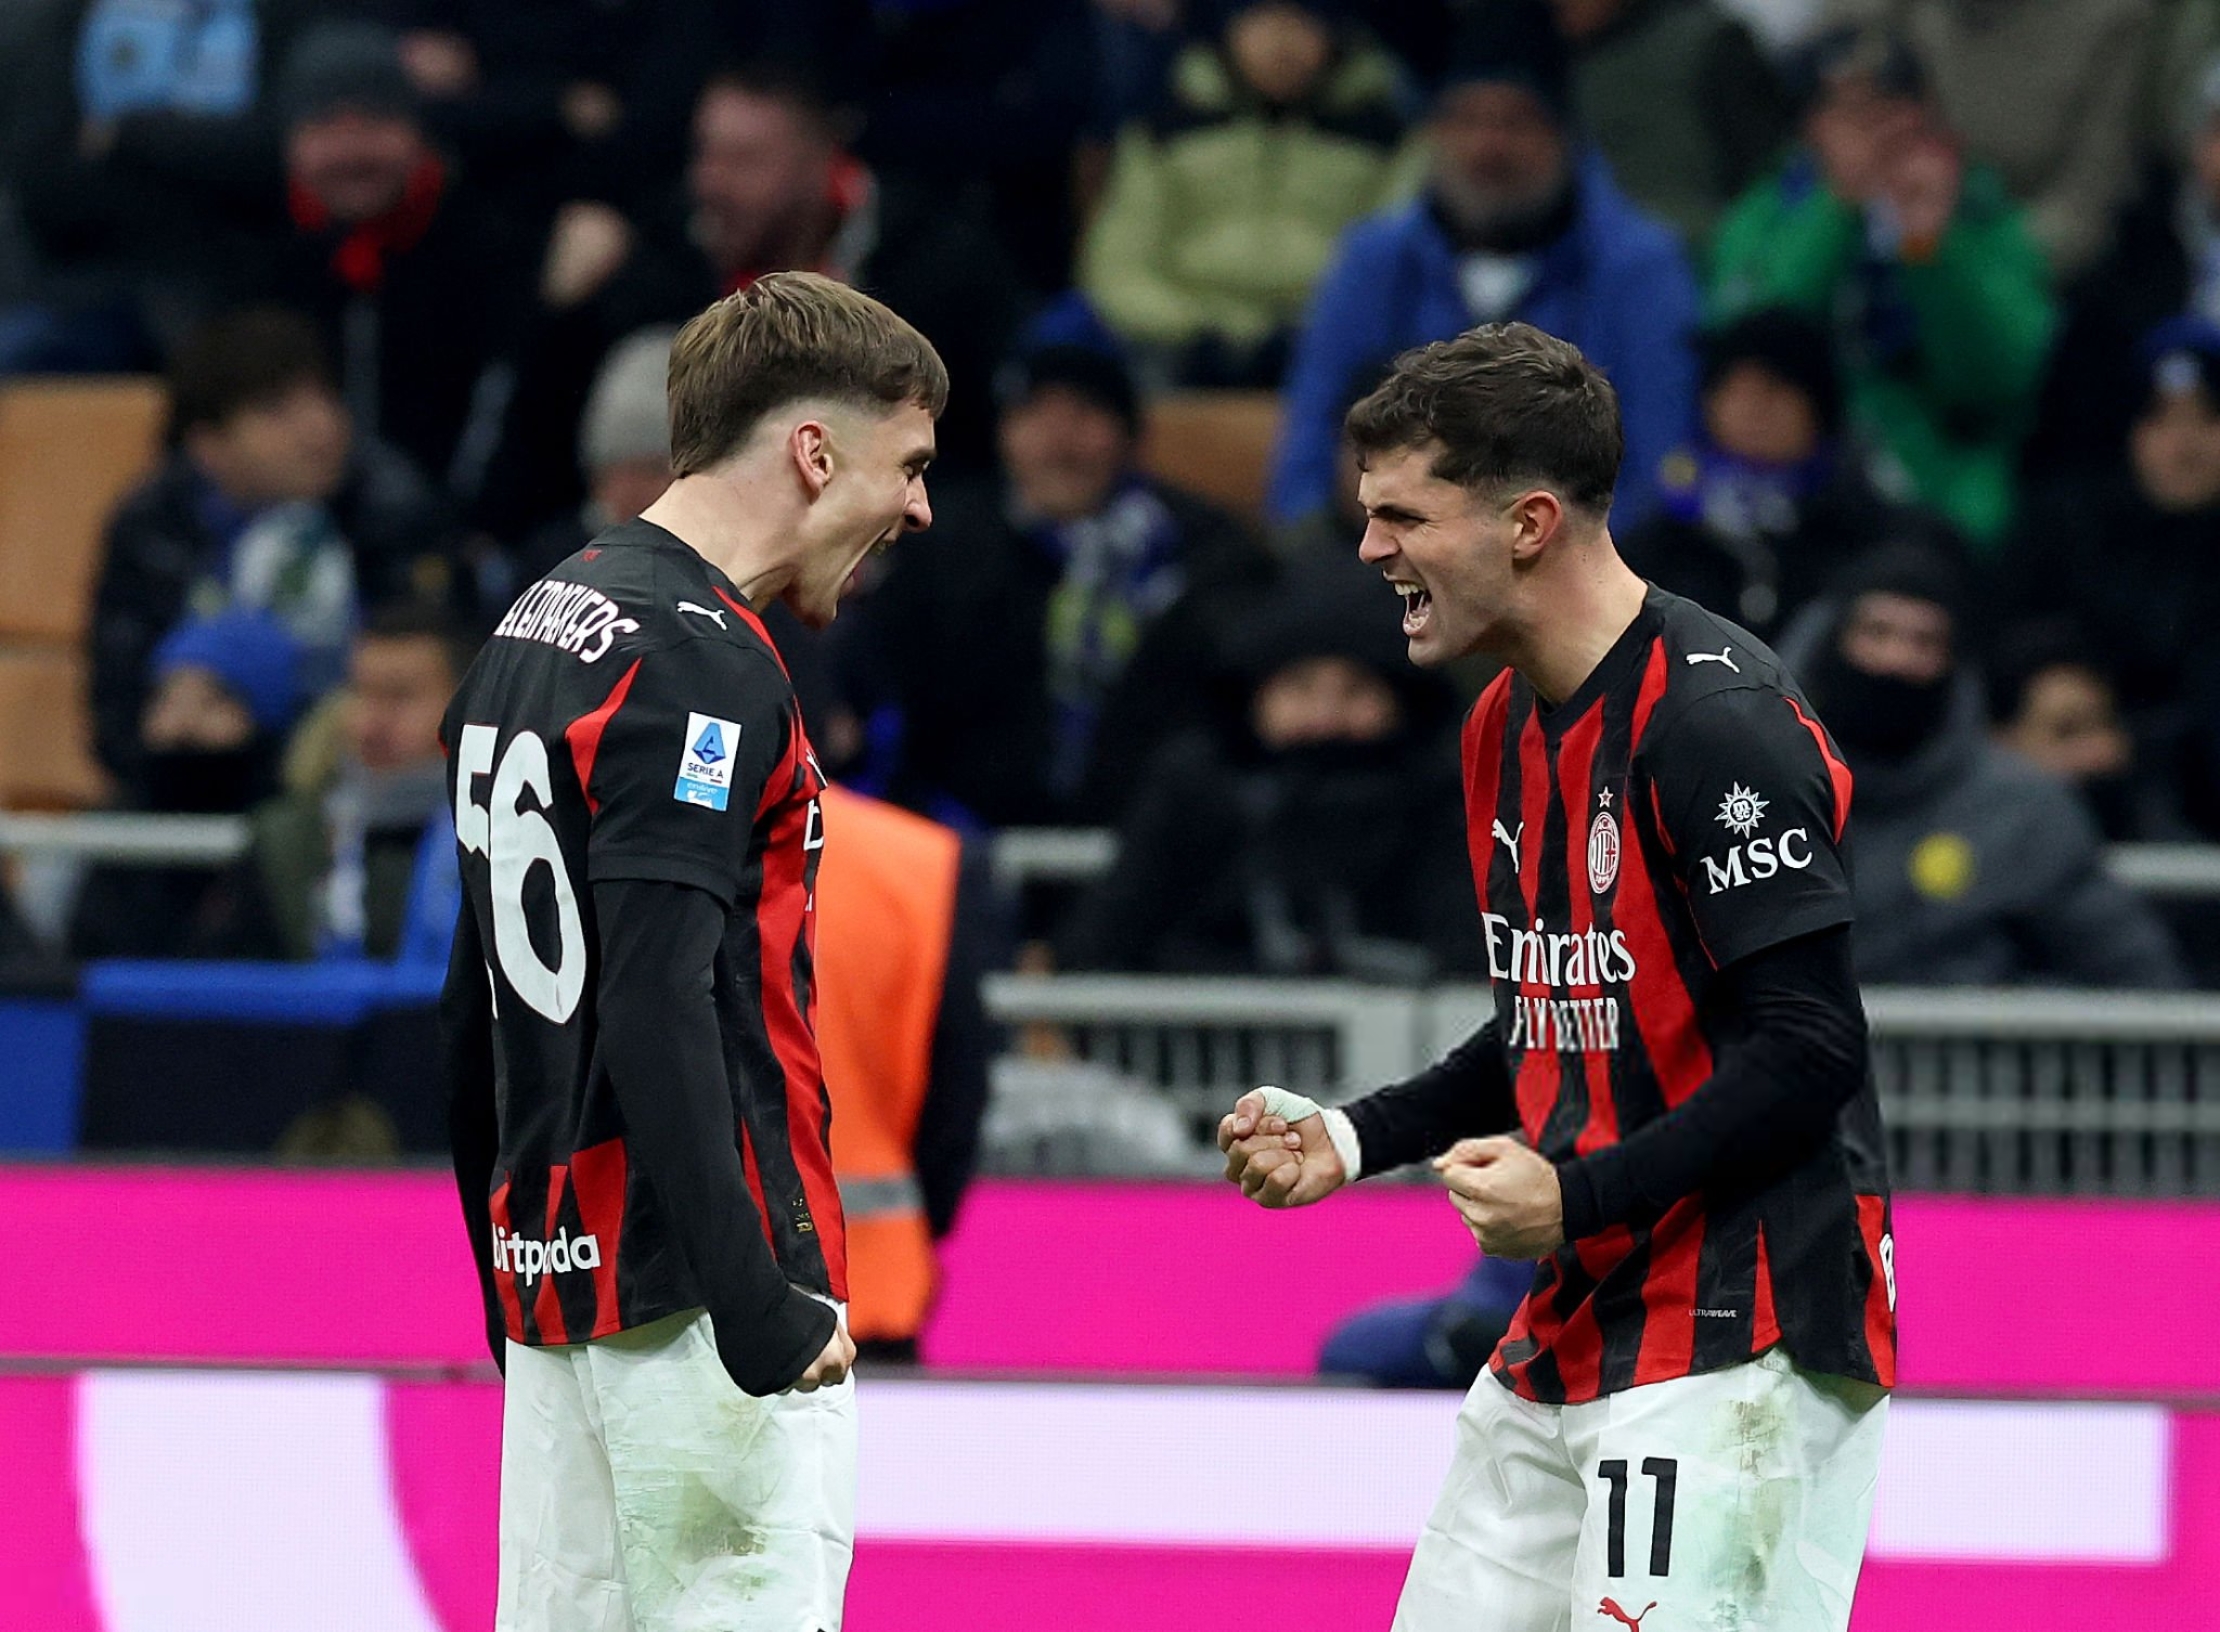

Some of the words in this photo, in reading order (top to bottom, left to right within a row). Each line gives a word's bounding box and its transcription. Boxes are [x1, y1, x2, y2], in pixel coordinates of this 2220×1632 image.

[687, 762, 715, 777] SERIE
[716, 769, 724, 779] A
[456, 724, 587, 1025] 56
[1699, 827, 1813, 895] MSC
[1481, 911, 1636, 986] Emirates
[1598, 1456, 1678, 1578] 11
